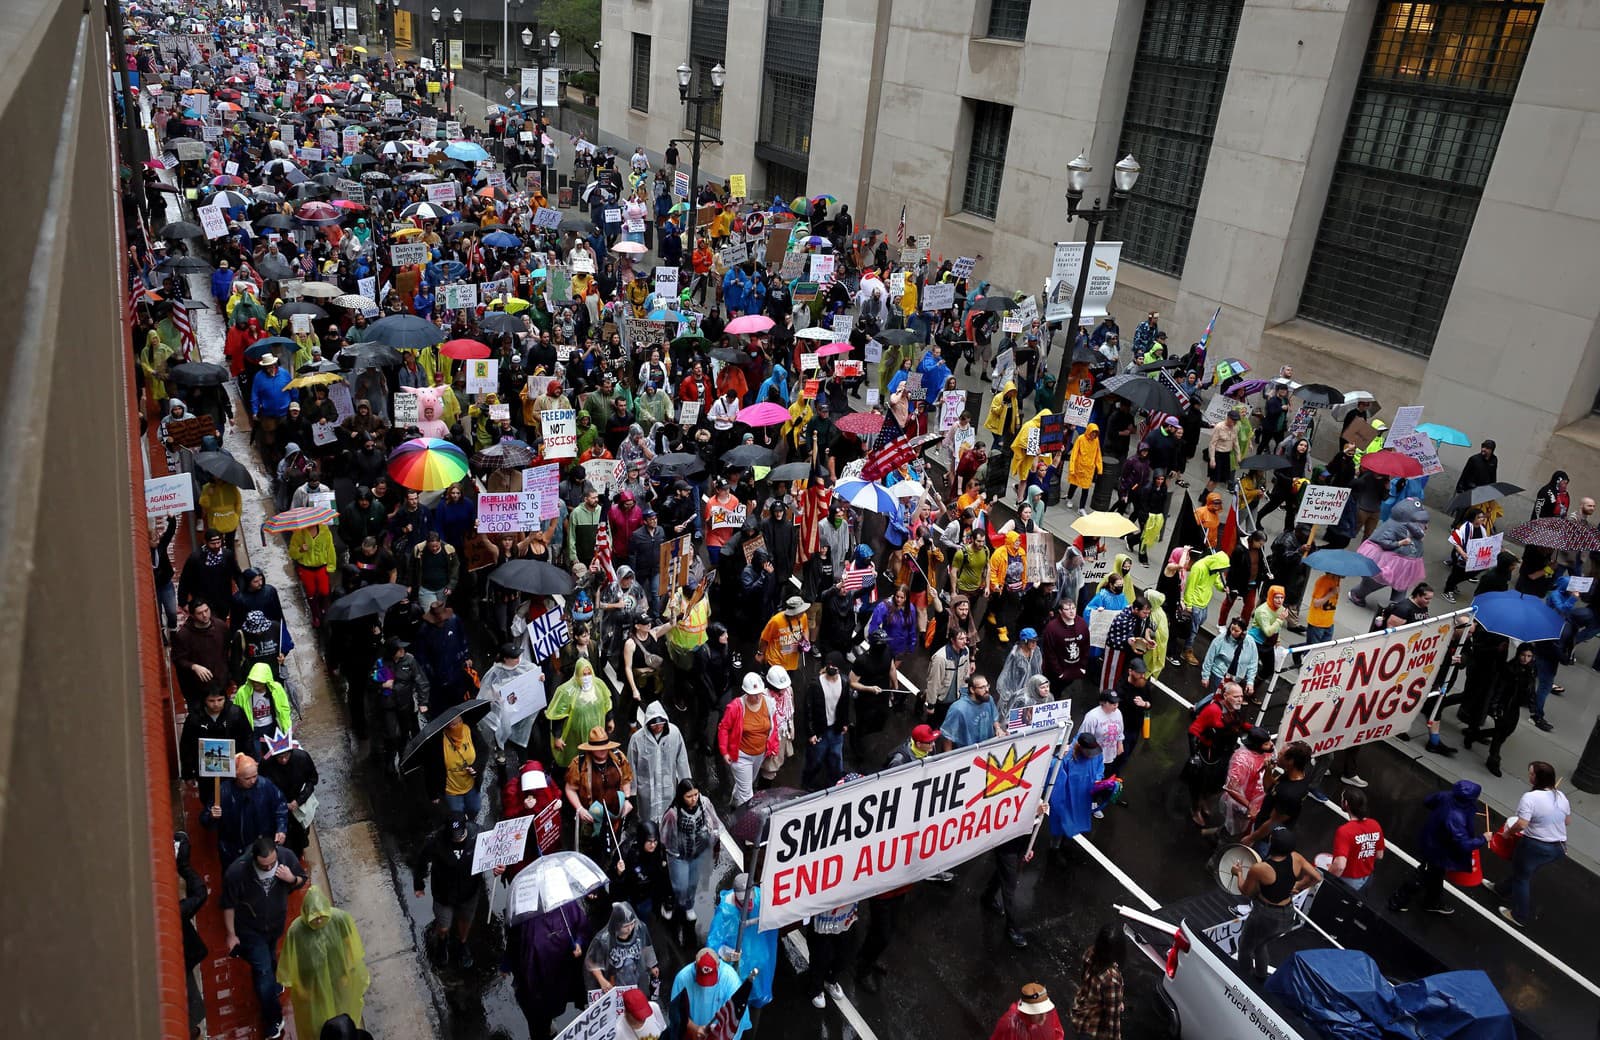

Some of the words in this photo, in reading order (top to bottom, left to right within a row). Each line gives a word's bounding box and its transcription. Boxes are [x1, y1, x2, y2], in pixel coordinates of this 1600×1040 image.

[656, 274, 677, 283] KINGS
[542, 410, 576, 421] FREEDOM
[550, 424, 565, 434] NOT
[150, 493, 177, 504] AGAINST
[481, 495, 518, 504] REBELLION
[1308, 487, 1324, 496] Just
[1336, 489, 1349, 502] NO
[489, 502, 526, 512] TYRANTS
[1301, 509, 1338, 521] Immunity
[481, 513, 519, 523] OBEDIENCE
[487, 522, 511, 532] GOD
[1413, 635, 1440, 652] NOT
[1312, 658, 1346, 677] NOT
[1346, 643, 1406, 691] NO
[1407, 651, 1438, 671] NOW
[1301, 673, 1342, 693] THEN
[1034, 703, 1060, 714] AMERICA
[1062, 701, 1070, 709] IS
[1285, 677, 1427, 743] KINGS
[1312, 735, 1344, 753] NOT
[1353, 724, 1393, 744] EVER
[777, 787, 901, 863] SMASH
[912, 766, 971, 823] THE
[772, 854, 843, 906] END
[853, 791, 1029, 881] AUTOCRACY
[563, 996, 611, 1040] KINGS
[1223, 985, 1248, 1015] Truck
[1248, 1012, 1276, 1040] Share
[583, 1014, 607, 1039] ICE
